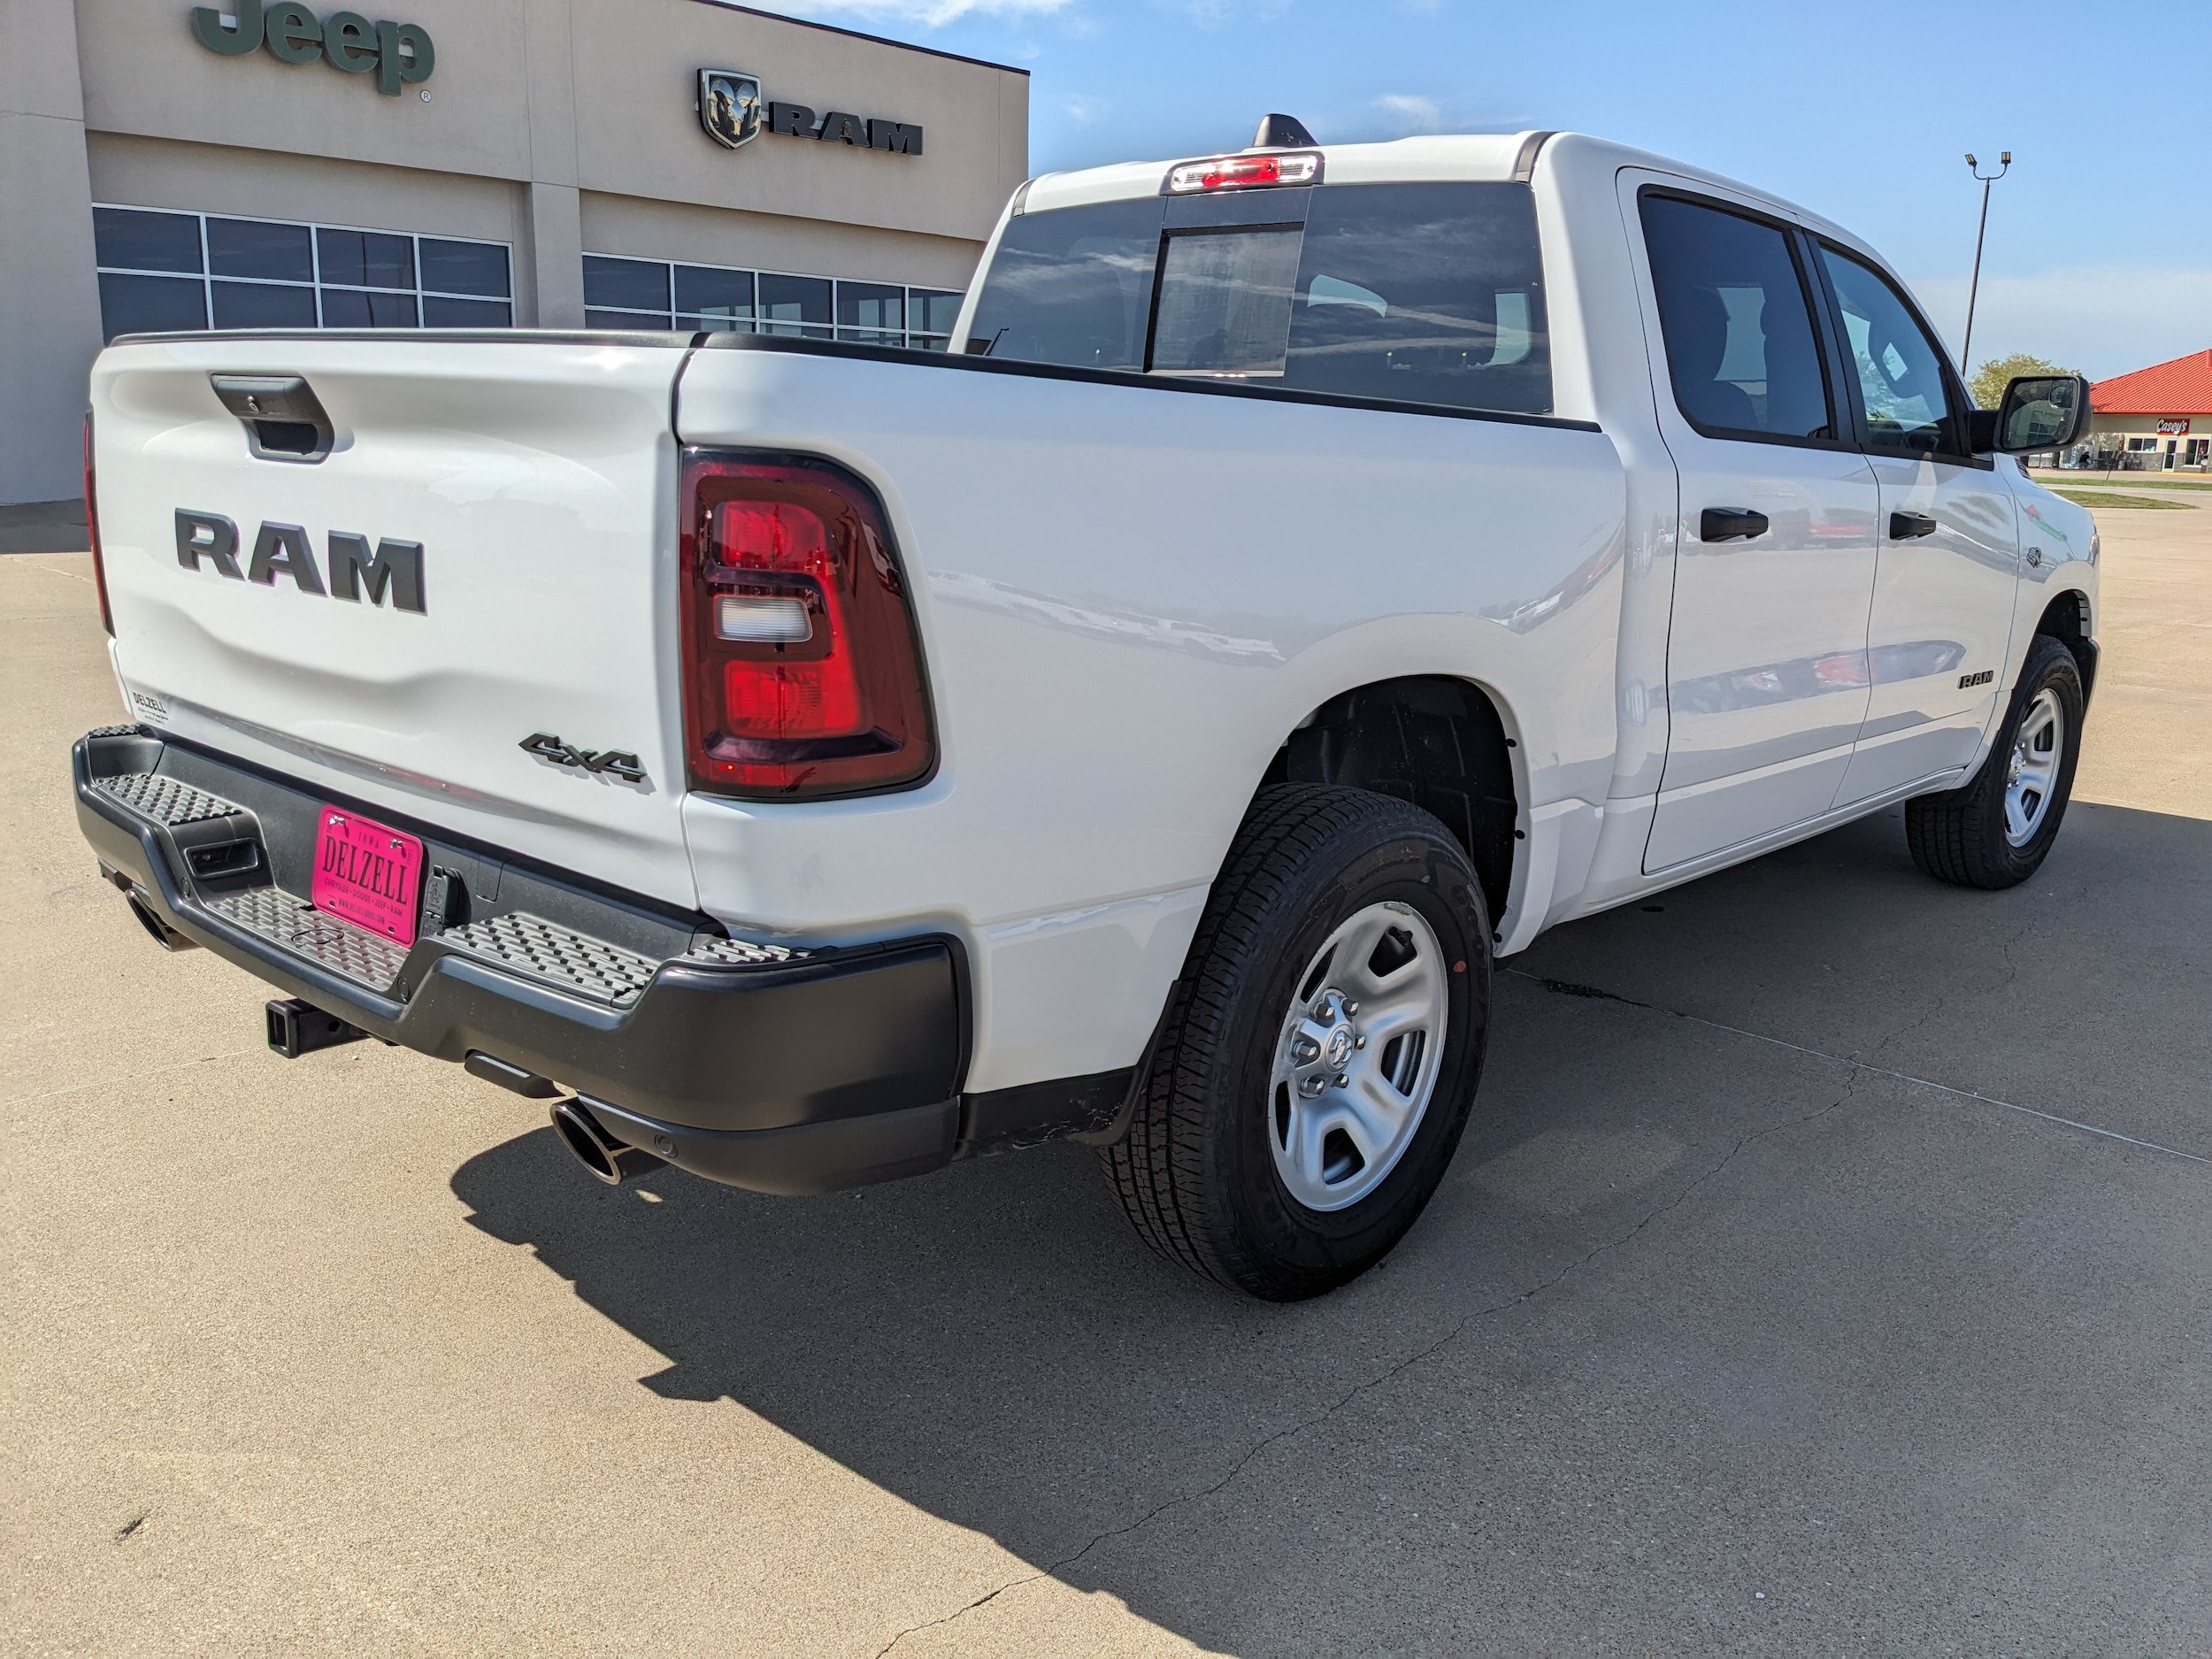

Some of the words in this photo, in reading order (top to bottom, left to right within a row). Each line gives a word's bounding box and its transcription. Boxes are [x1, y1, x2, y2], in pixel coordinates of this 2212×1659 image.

[192, 0, 435, 96] Jeep
[769, 100, 924, 156] RAM
[2156, 419, 2188, 435] Casey's
[174, 507, 427, 615] RAM
[133, 691, 167, 714] DELZELL
[1957, 670, 1994, 689] RAM
[322, 835, 409, 905] DELZELL
[325, 878, 349, 895] CHRYSLER
[352, 886, 372, 903] DODGE
[374, 897, 388, 910] JEEP
[390, 904, 403, 917] RAM
